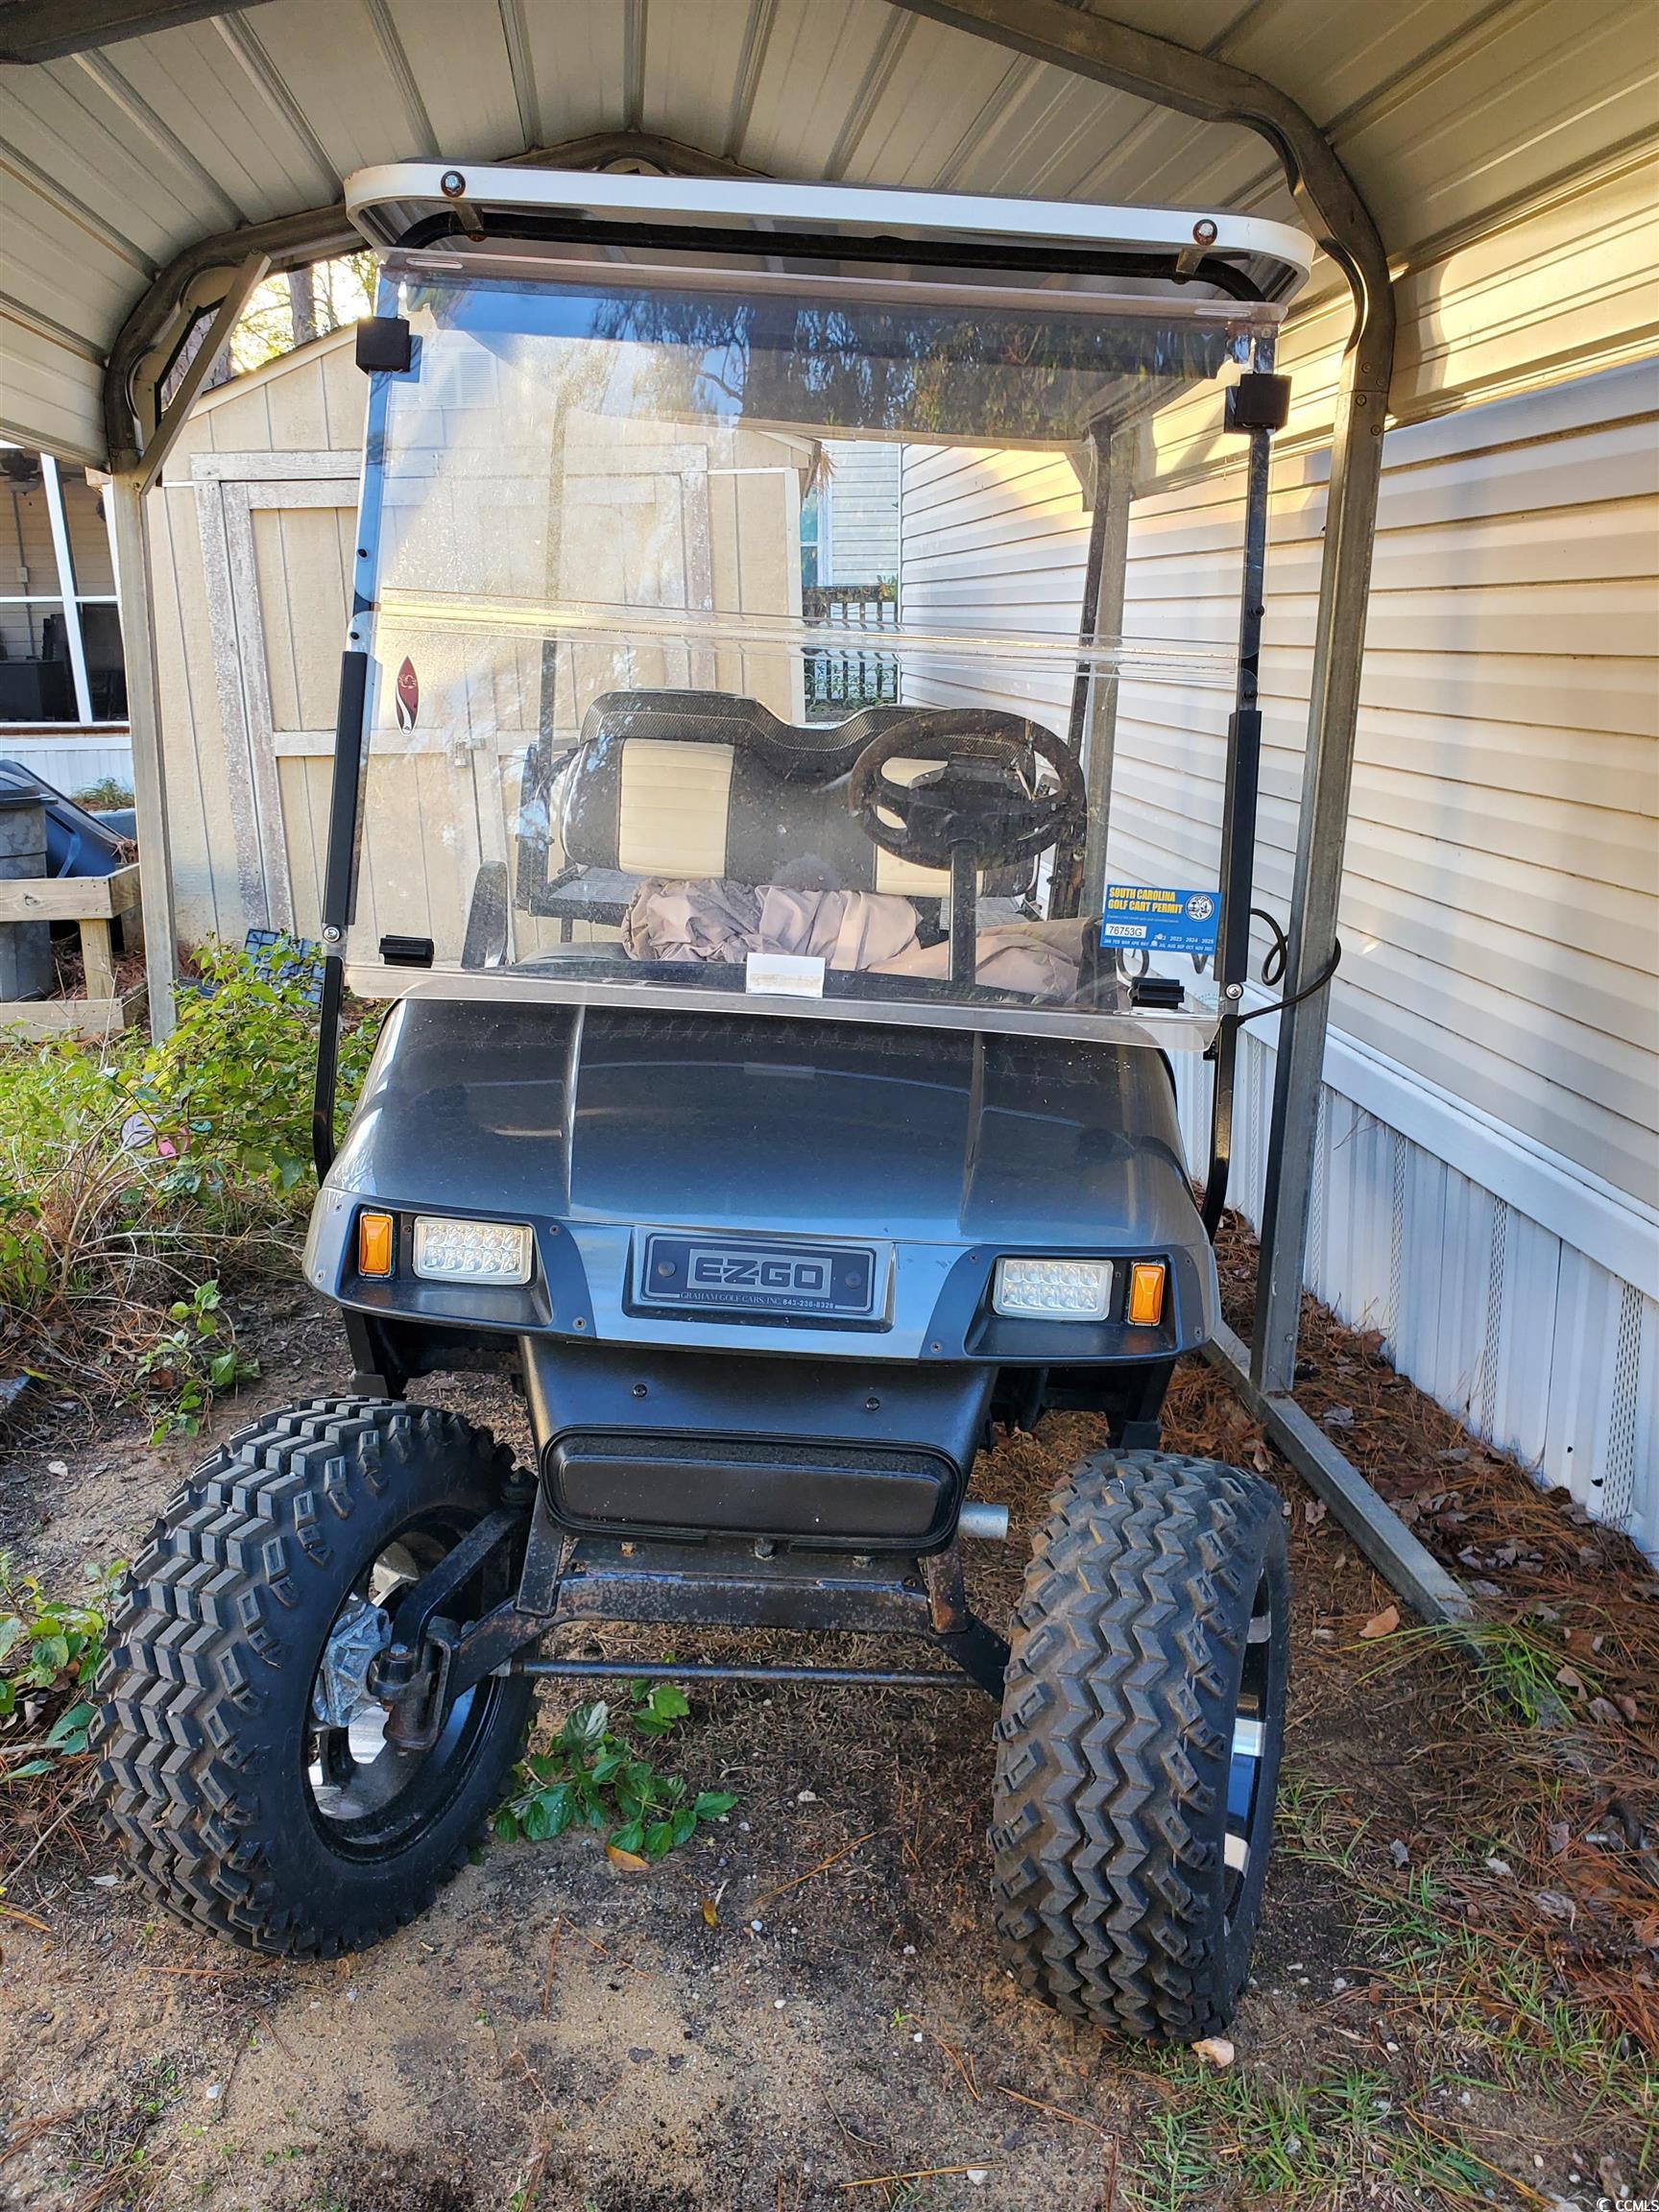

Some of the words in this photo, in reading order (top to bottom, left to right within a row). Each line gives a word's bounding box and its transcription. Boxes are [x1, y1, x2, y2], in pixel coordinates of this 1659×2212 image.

[1109, 887, 1136, 899] SOUTH
[1137, 889, 1176, 902] CAROLINA
[1108, 899, 1128, 910] GOLF
[1129, 901, 1151, 912] CART
[1152, 902, 1184, 914] PERMIT
[1109, 926, 1142, 937] 76753G
[694, 1256, 824, 1290] EZGO
[680, 1291, 718, 1300] GRAHAM
[718, 1293, 741, 1302] GOLF
